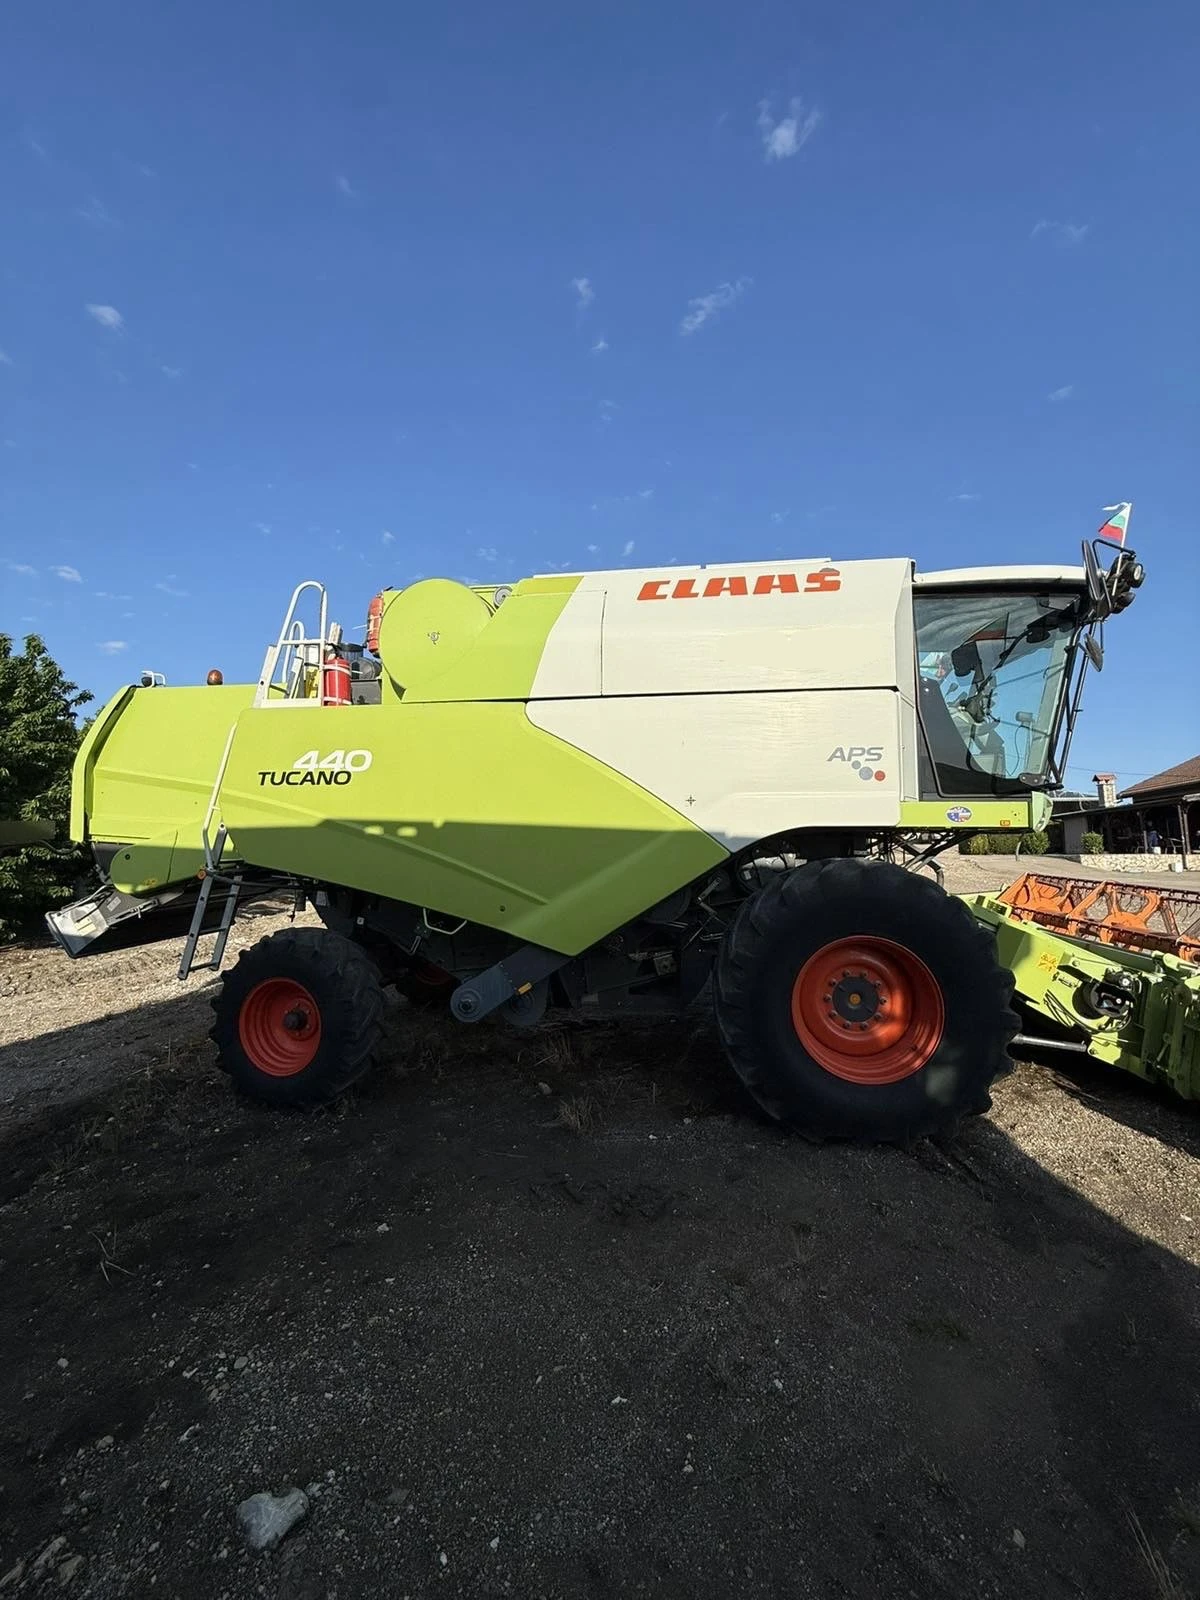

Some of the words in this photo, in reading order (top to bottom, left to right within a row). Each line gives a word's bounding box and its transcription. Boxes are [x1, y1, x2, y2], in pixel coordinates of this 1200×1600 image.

[636, 567, 842, 601] CLAAS
[292, 749, 373, 772] 440
[827, 746, 884, 762] APS
[258, 770, 352, 786] TUCANO
